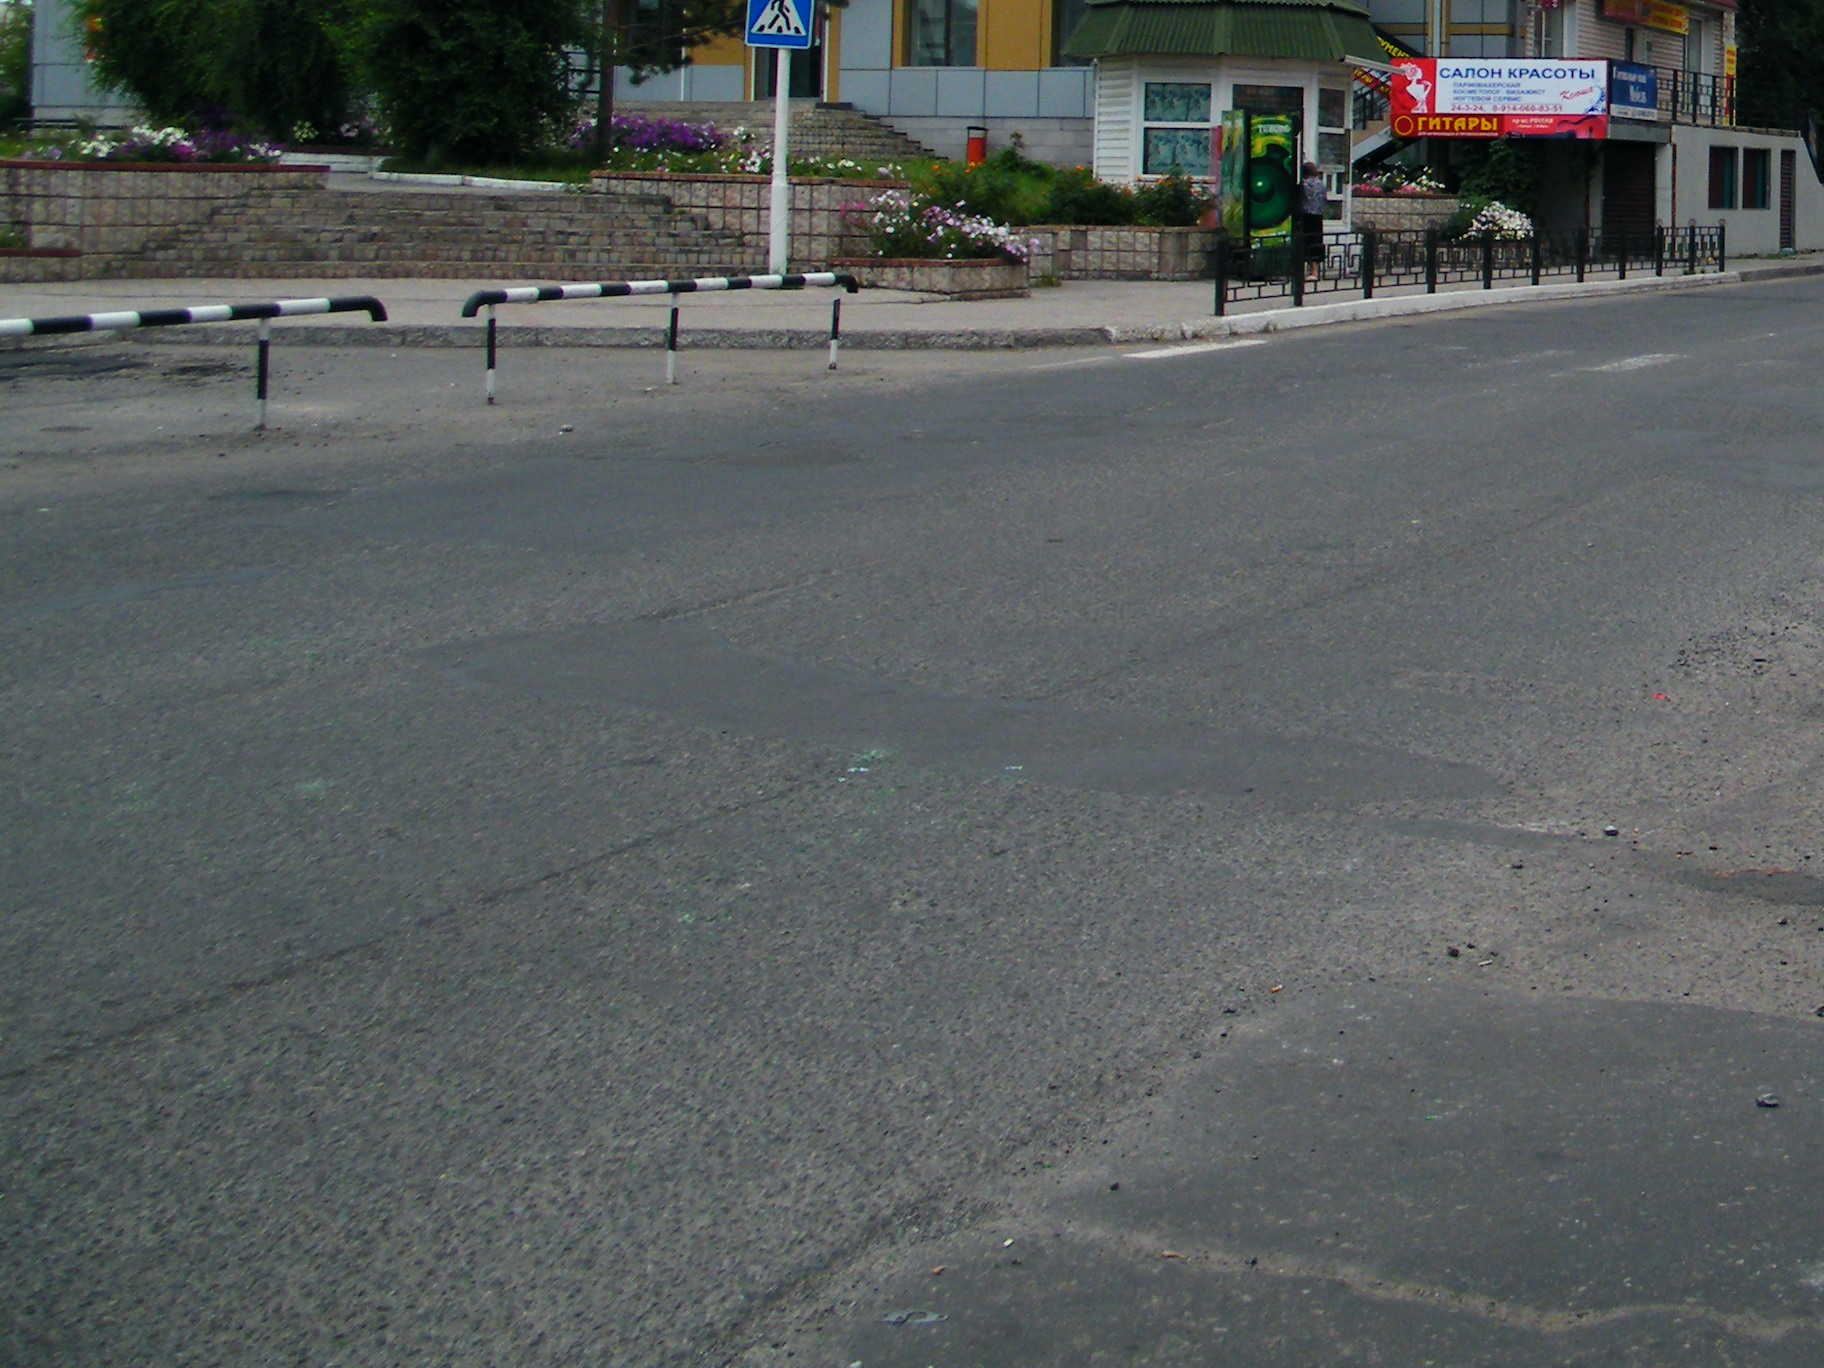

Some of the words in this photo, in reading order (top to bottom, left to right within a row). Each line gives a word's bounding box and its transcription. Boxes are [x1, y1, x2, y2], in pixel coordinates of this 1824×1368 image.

[1439, 66, 1502, 80] САЛОН
[1507, 66, 1596, 80] КРАСОТЫ
[1417, 115, 1499, 132] ГИТАРЫ
